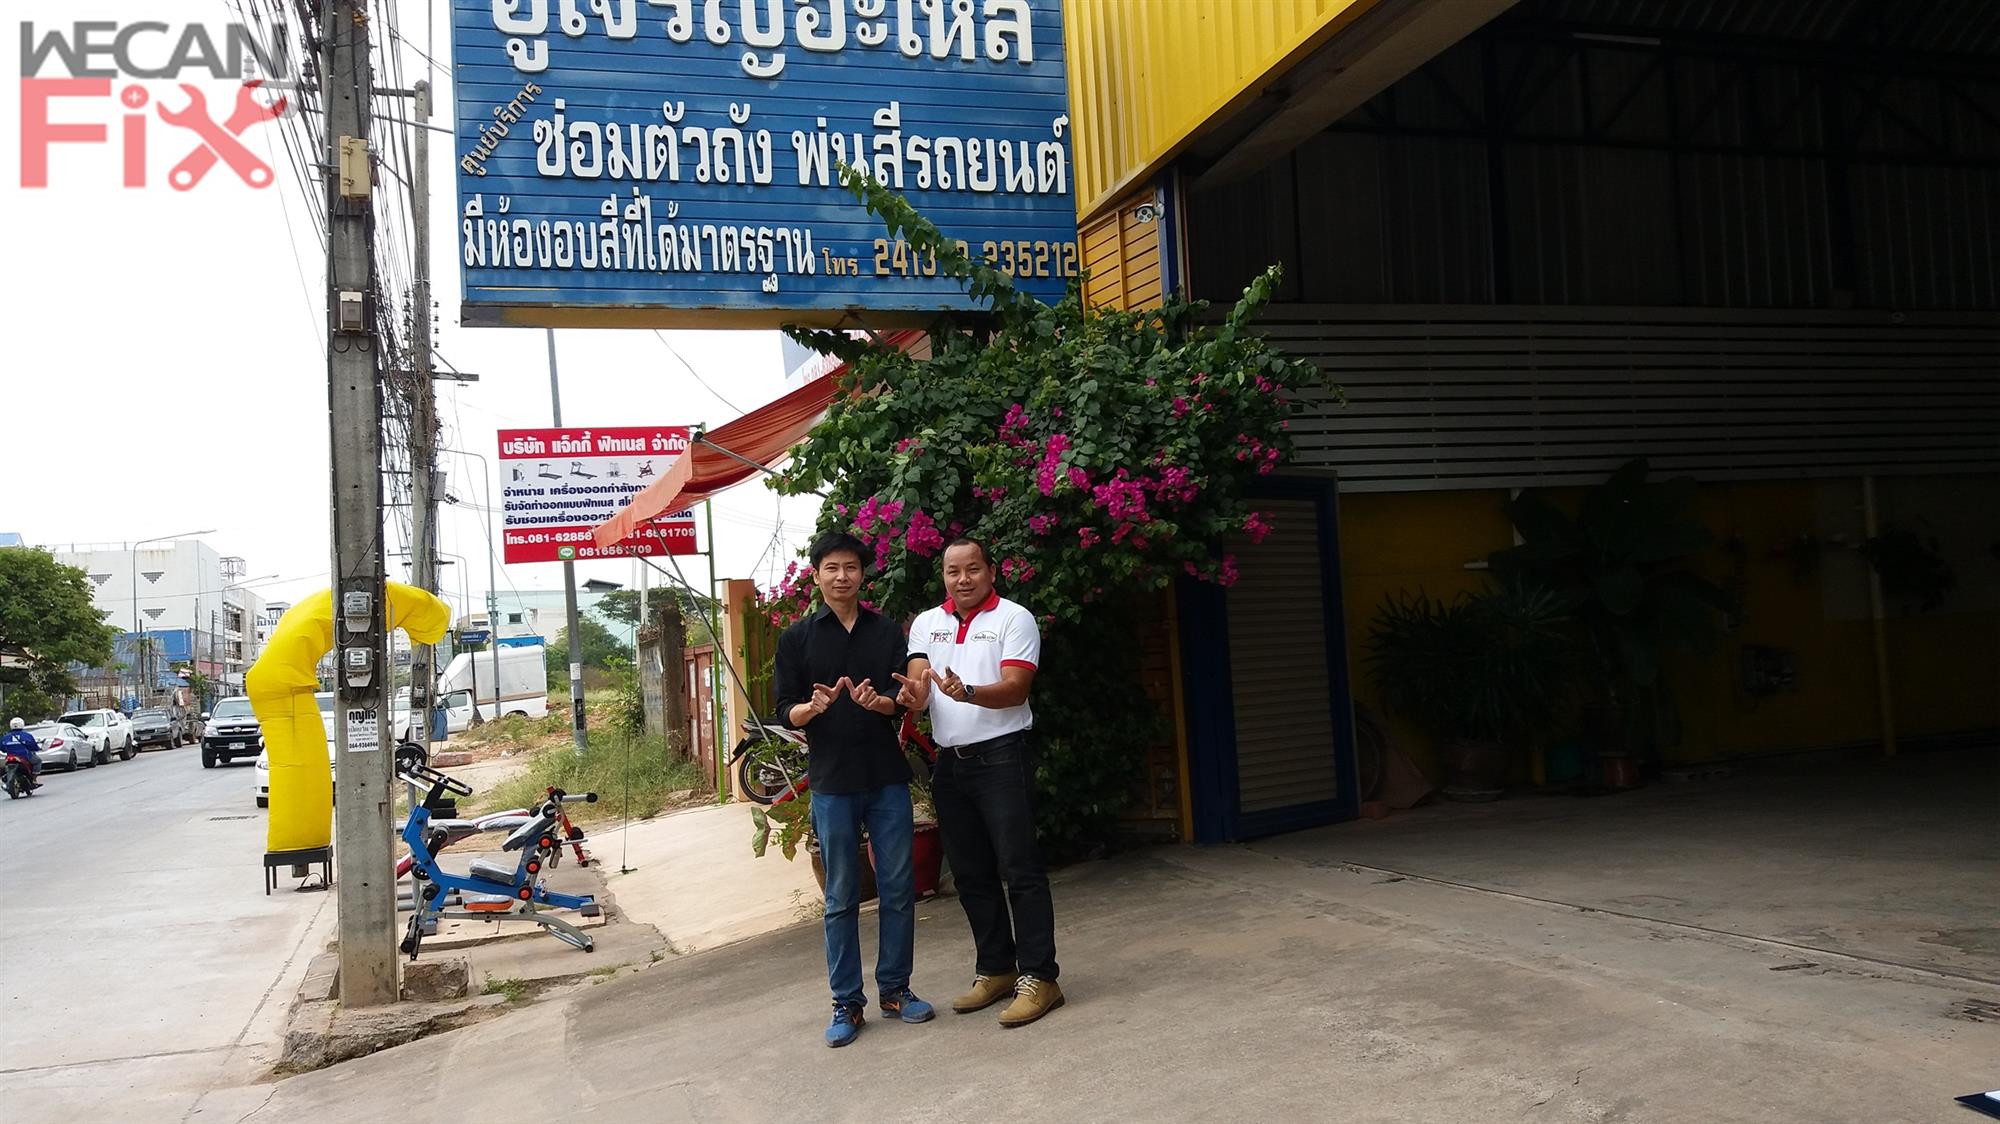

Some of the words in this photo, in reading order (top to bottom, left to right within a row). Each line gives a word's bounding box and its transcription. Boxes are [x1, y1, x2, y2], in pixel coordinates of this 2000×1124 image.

[461, 81, 542, 176] ศูนย์บริการ
[534, 98, 773, 184] ซ่อมตัวถัง
[791, 101, 1069, 194] พ่นสีรถยนต์
[463, 187, 816, 292] มีห้องอบสีที่ได้มาตรฐาน
[822, 246, 858, 276] โทร
[503, 436, 546, 455] บริษัท
